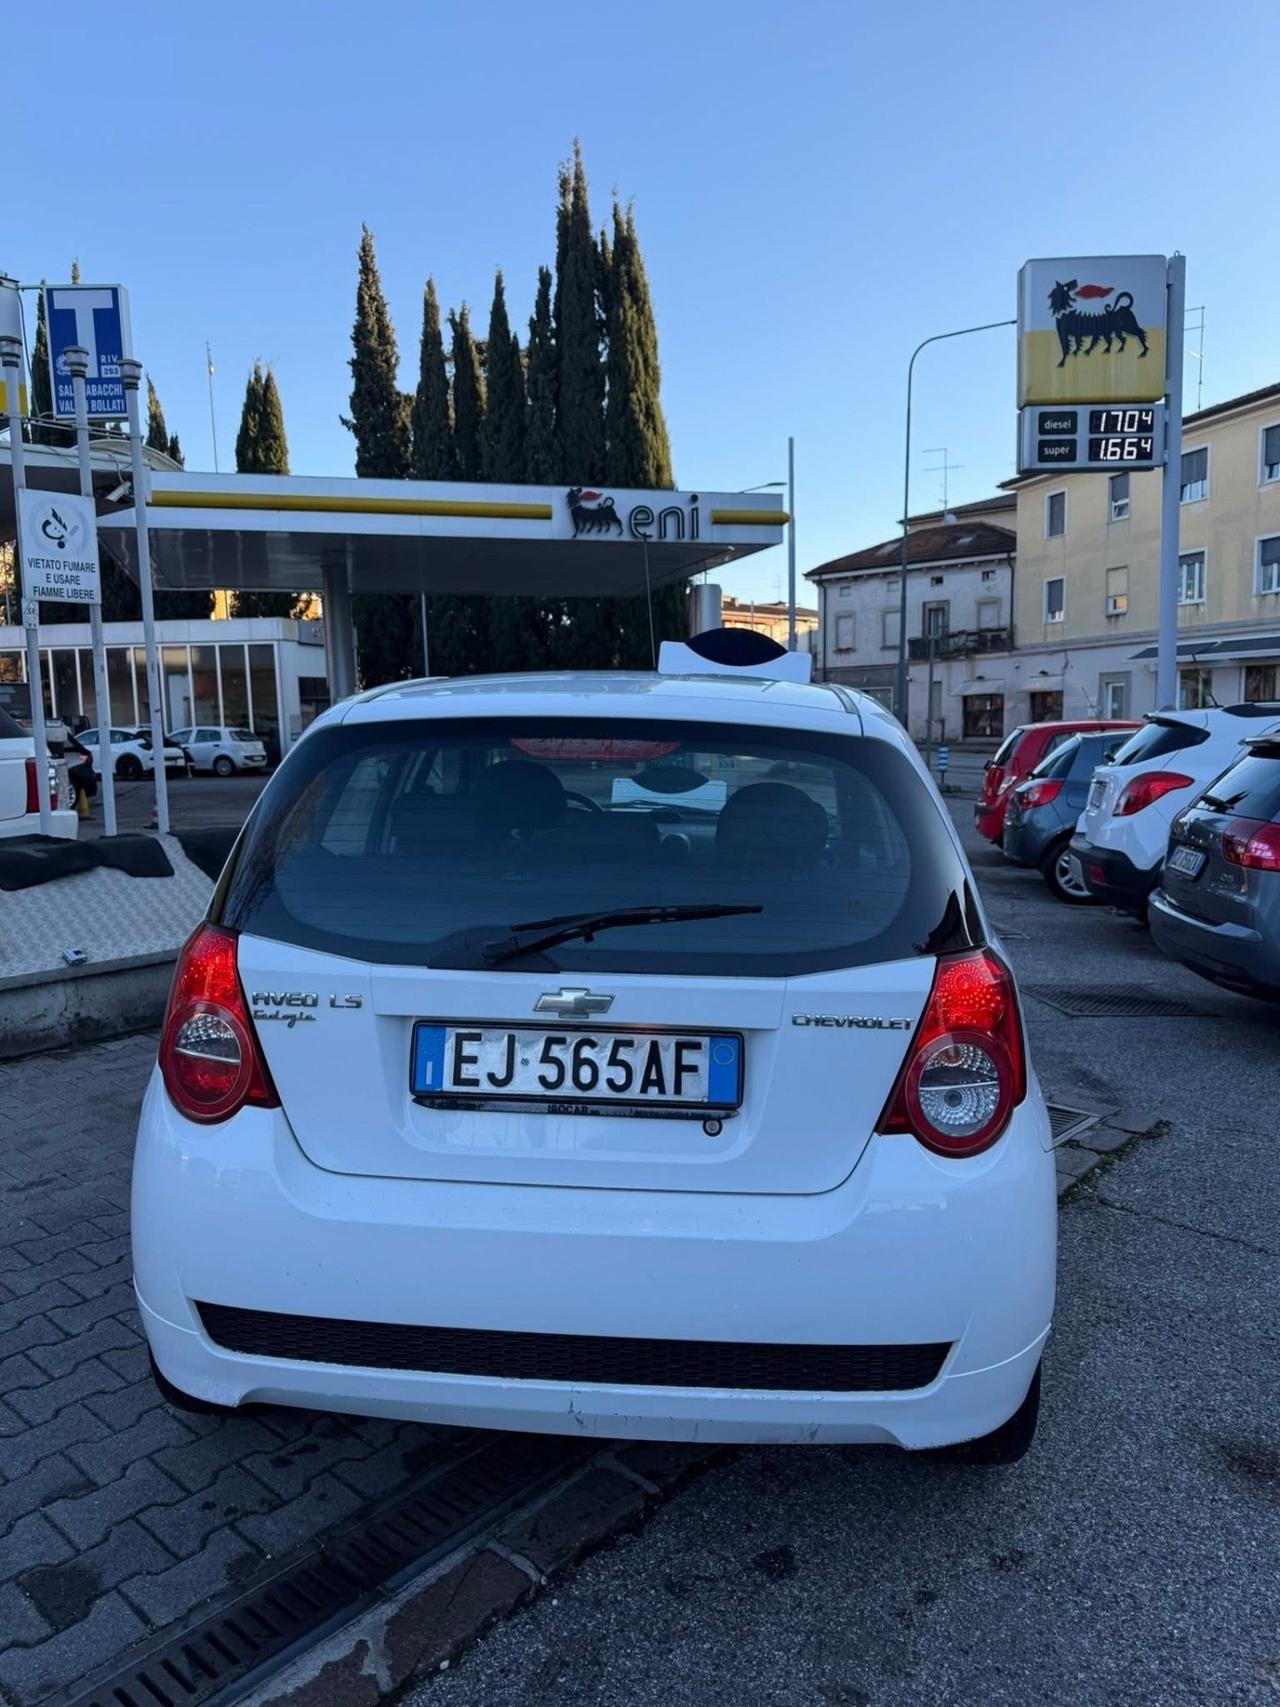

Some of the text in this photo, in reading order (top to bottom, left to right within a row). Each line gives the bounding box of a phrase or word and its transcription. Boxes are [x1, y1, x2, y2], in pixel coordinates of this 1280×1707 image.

[53, 289, 113, 378] T
[58, 384, 123, 397] SAL ABACCHI
[91, 399, 125, 412] BOLLATI
[1044, 420, 1071, 430] diesel
[1044, 446, 1070, 457] super
[629, 494, 699, 541] eni
[27, 557, 96, 573] VIETATO FUMARE
[46, 573, 81, 585] E USARE
[33, 586, 95, 600] FIAMME LIBERE
[252, 992, 362, 1009] AVEO LS
[791, 1013, 915, 1030] CHEVROLET
[452, 1032, 516, 1088] EJ
[538, 1035, 702, 1096] 565AF
